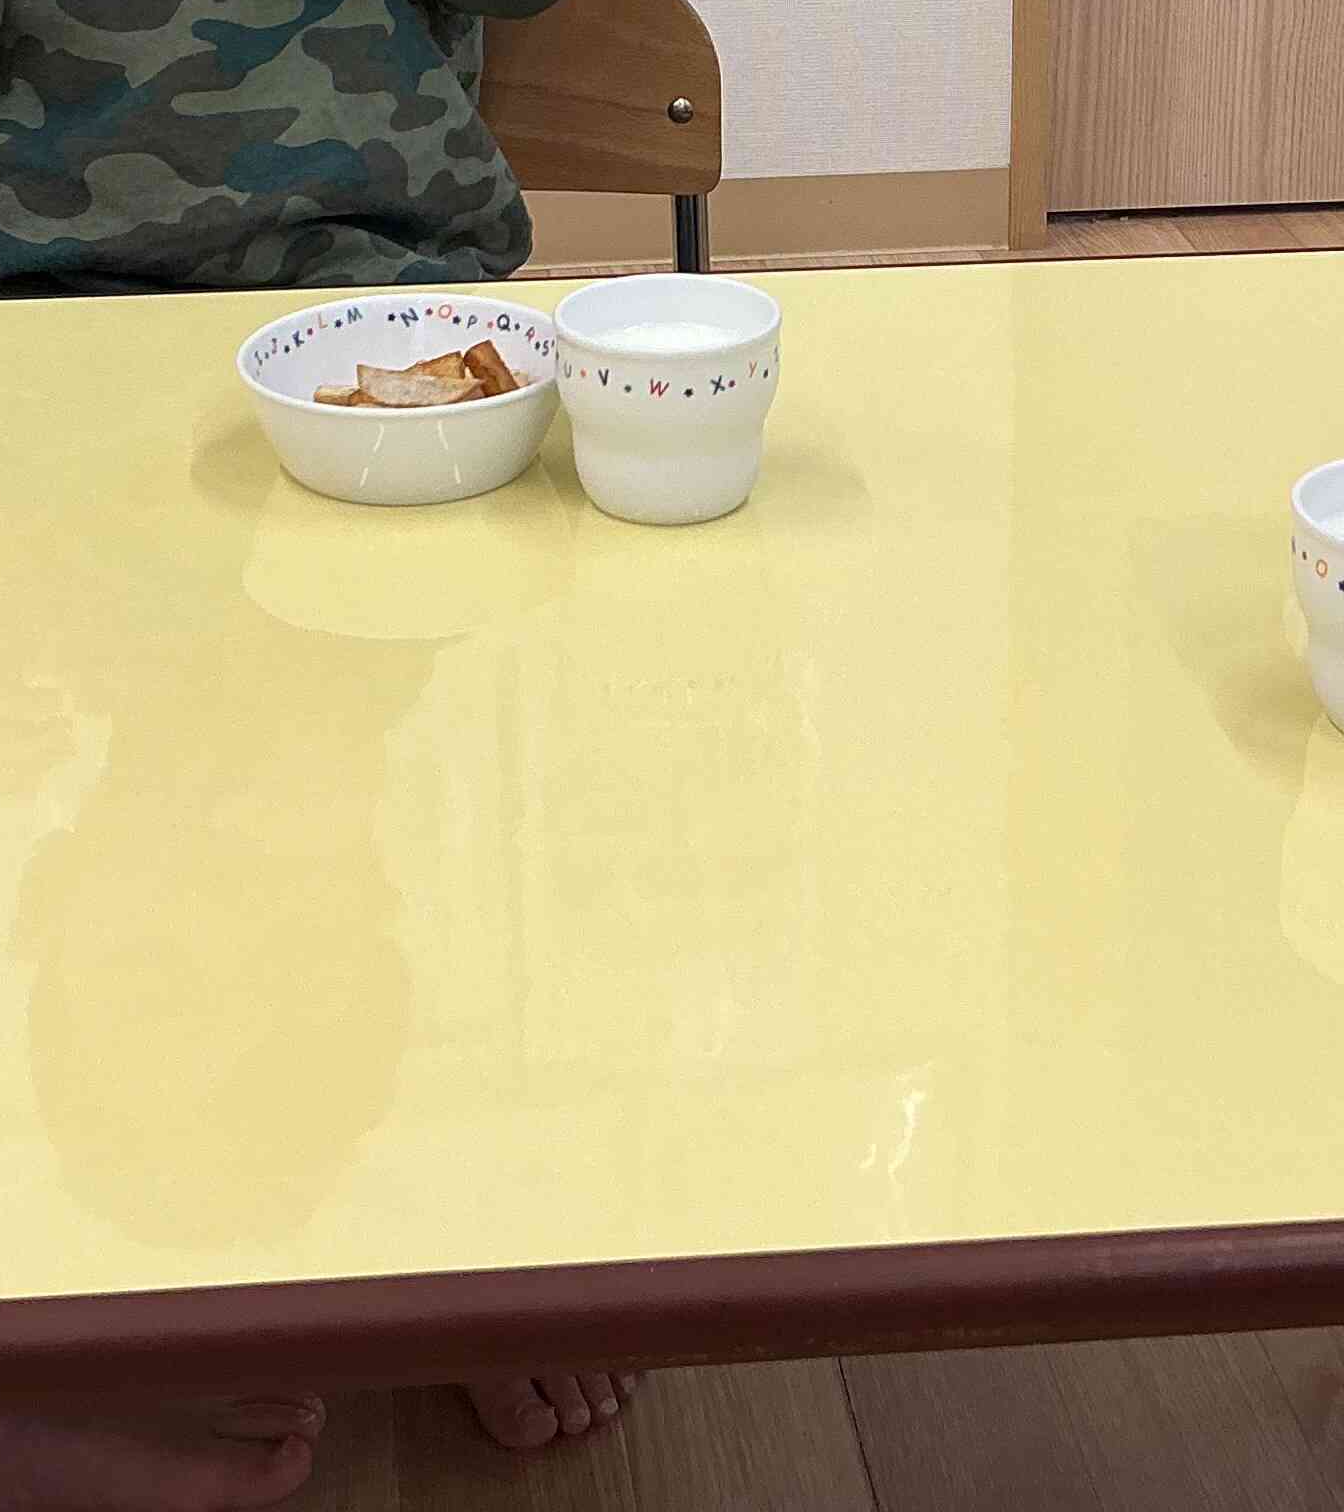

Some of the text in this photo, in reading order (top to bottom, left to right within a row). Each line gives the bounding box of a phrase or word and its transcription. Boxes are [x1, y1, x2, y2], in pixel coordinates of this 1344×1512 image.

[598, 369, 609, 386] V
[649, 377, 669, 397] W
[710, 375, 725, 395] X
